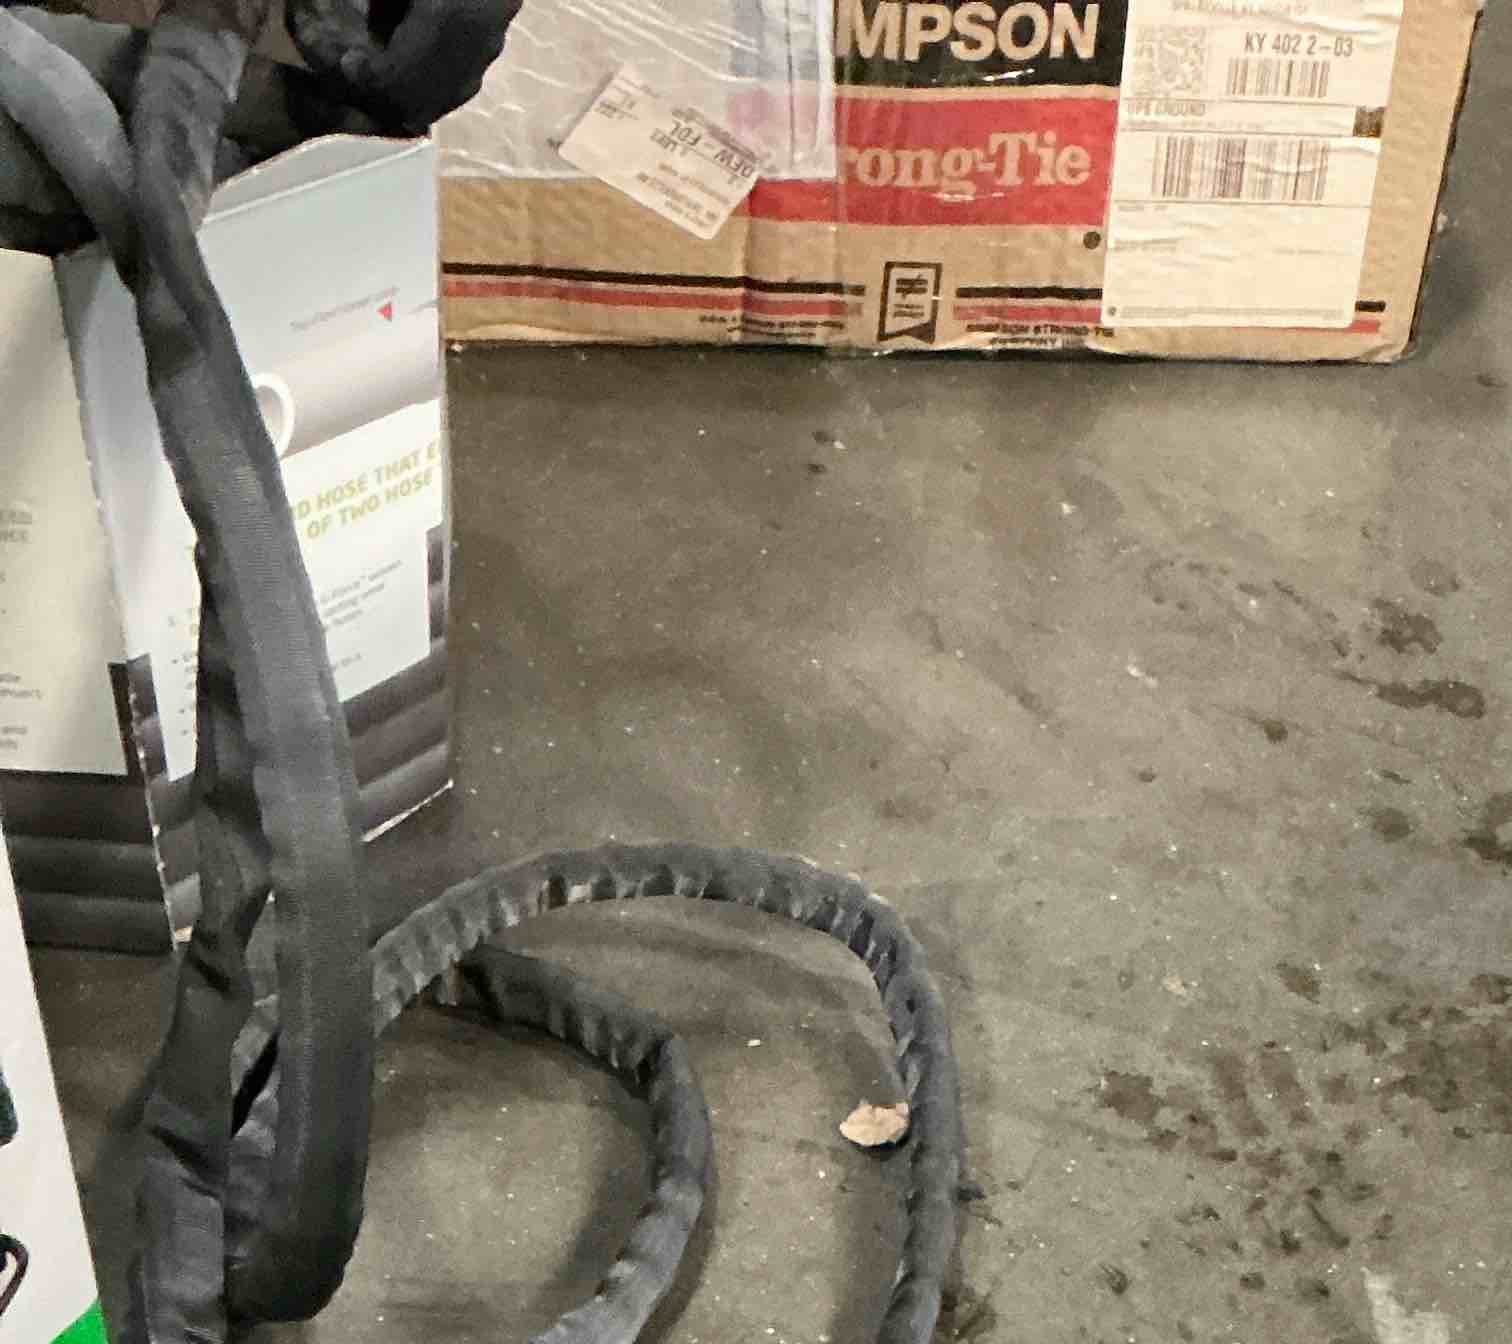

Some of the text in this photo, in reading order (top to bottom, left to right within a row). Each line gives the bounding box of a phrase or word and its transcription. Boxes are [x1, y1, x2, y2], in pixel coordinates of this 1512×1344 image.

[836, 0, 1099, 61] MPSON
[1244, 31, 1268, 55] KY
[1271, 34, 1300, 55] 402
[306, 466, 433, 539] OF TWO HOSE
[317, 472, 368, 510] HOSE
[373, 450, 421, 485] THAT
